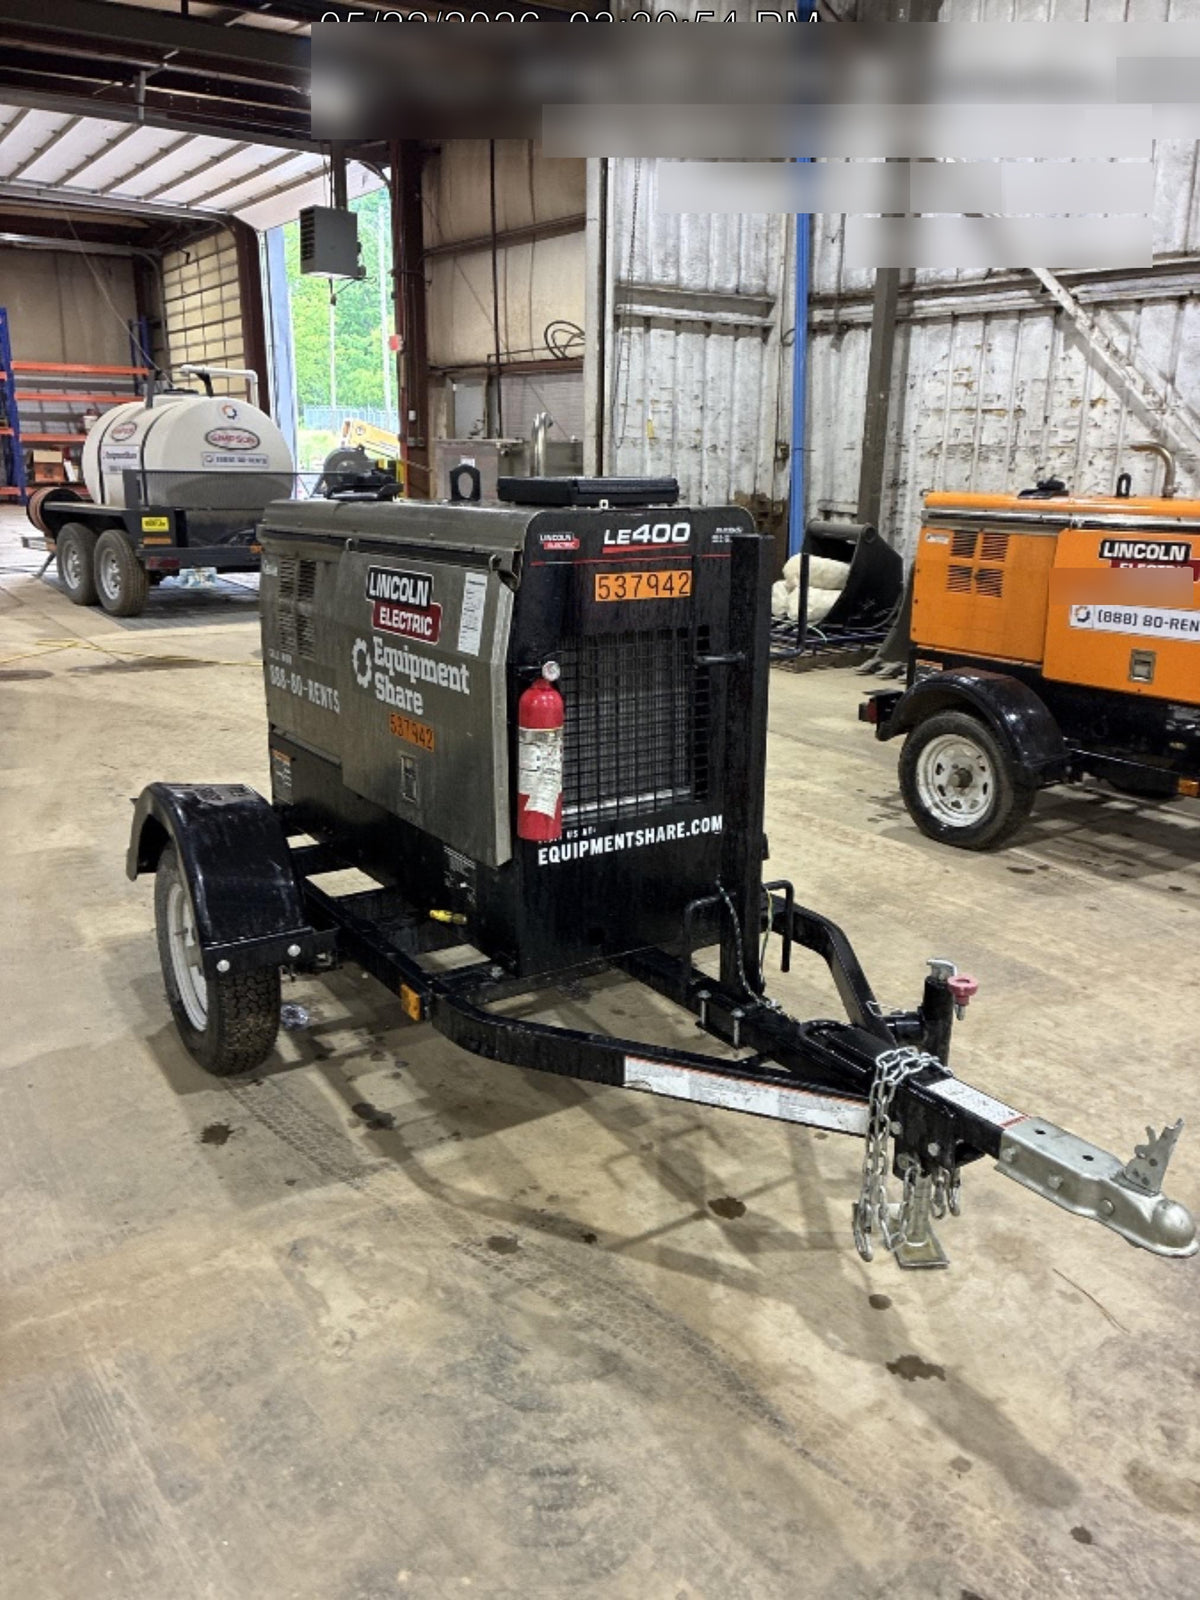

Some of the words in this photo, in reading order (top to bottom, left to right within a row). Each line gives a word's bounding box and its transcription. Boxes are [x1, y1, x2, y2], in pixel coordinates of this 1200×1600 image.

[539, 534, 572, 542] LINCOLN
[604, 522, 690, 545] LE400
[1103, 541, 1187, 561] LINCOLN
[369, 572, 429, 607] LINCOLN
[598, 571, 690, 600] 537942
[379, 606, 433, 636] ELECTRIC
[1097, 609, 1138, 627] (888)
[373, 636, 470, 695] Equipment
[374, 671, 424, 716] Share
[391, 713, 433, 750] 537942
[537, 814, 723, 866] EQUIPMENTSHARE.COM
